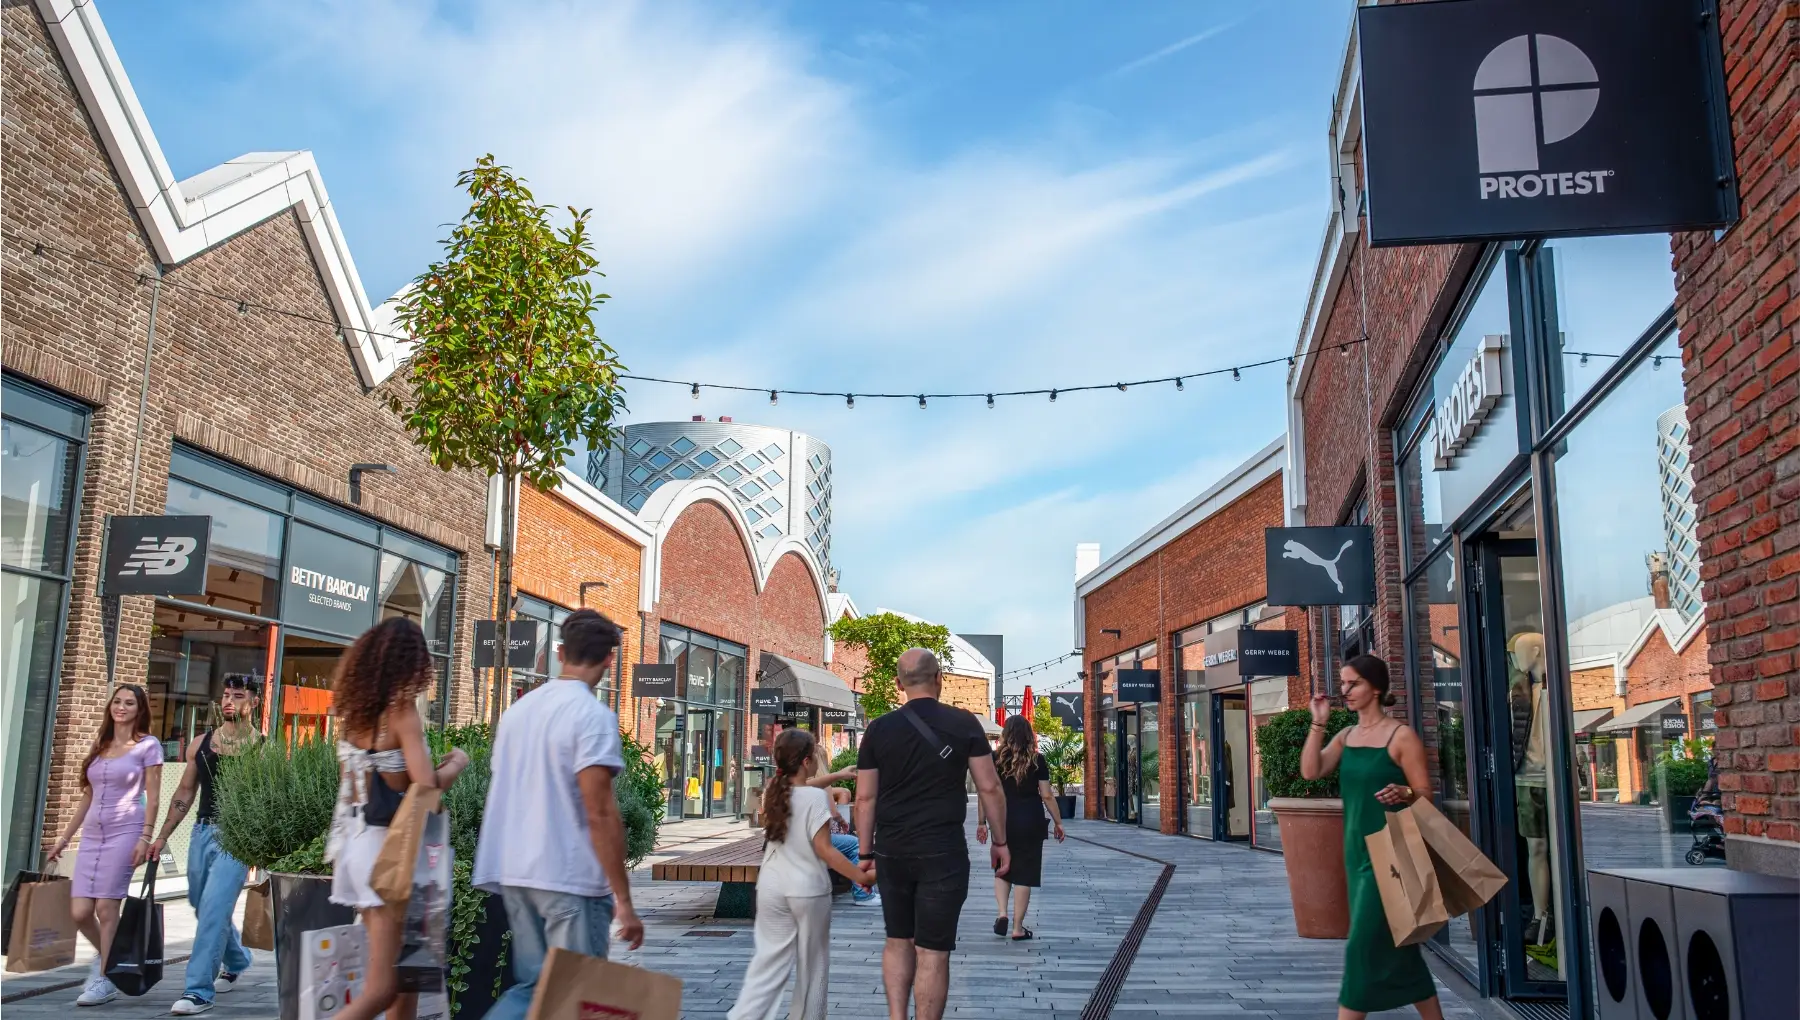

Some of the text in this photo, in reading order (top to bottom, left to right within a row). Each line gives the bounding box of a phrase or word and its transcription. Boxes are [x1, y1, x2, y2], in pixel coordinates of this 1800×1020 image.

[1437, 335, 1502, 458] PROTEST
[291, 566, 370, 602] BETTY BARCLAY
[308, 593, 352, 612] SELECTED BRANDS
